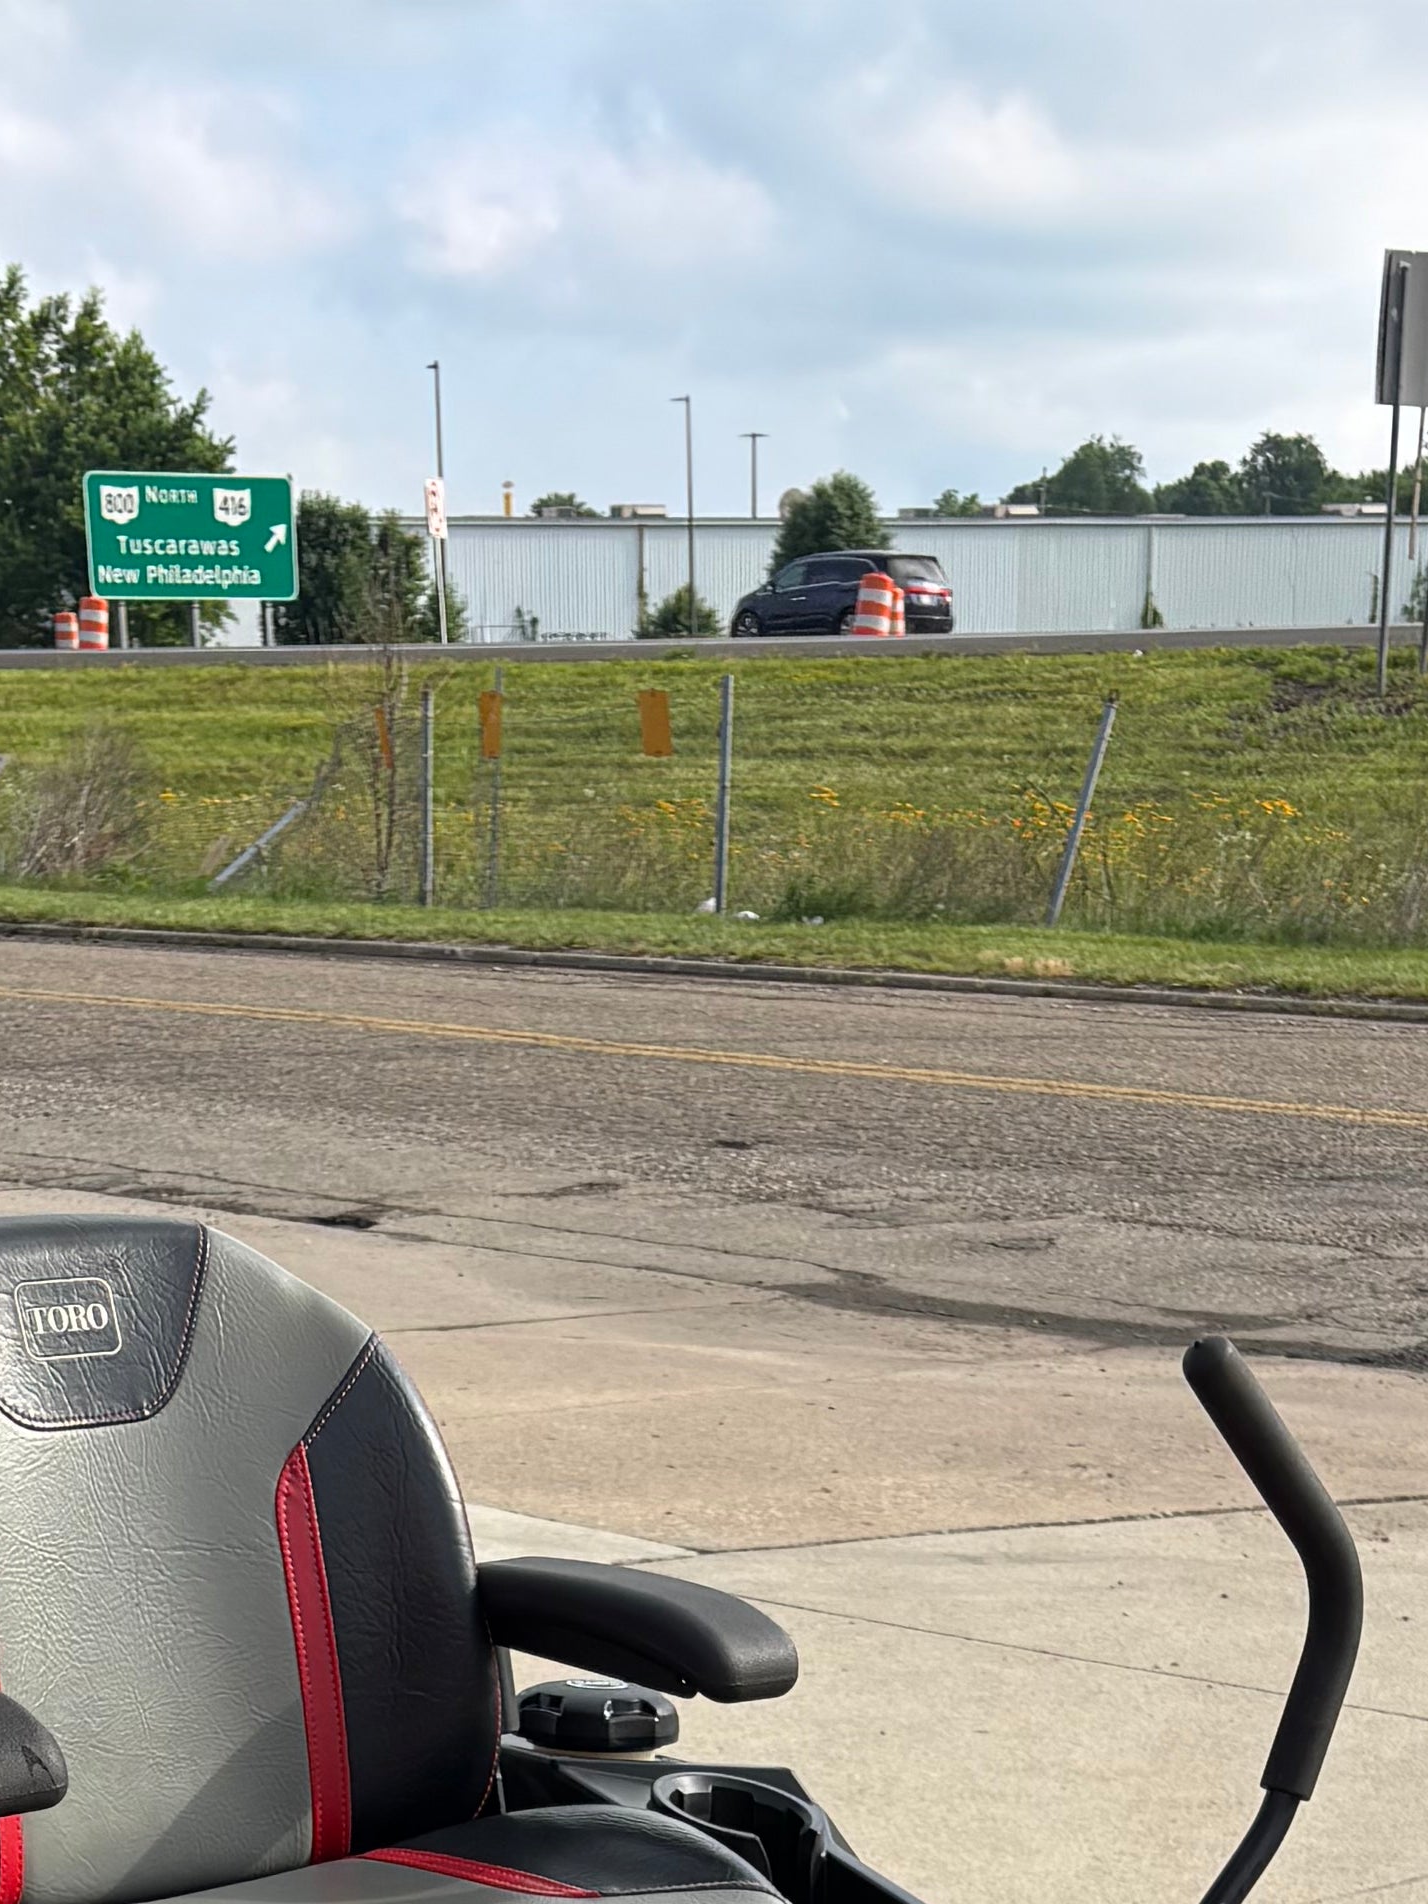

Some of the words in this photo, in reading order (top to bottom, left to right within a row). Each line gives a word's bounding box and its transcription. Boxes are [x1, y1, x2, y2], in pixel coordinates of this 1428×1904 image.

[105, 493, 134, 513] 800
[218, 495, 248, 516] 416
[116, 535, 240, 556] Tuscarawas
[98, 564, 140, 584] New
[146, 564, 261, 590] Philadelphia
[25, 1303, 109, 1335] TORO
